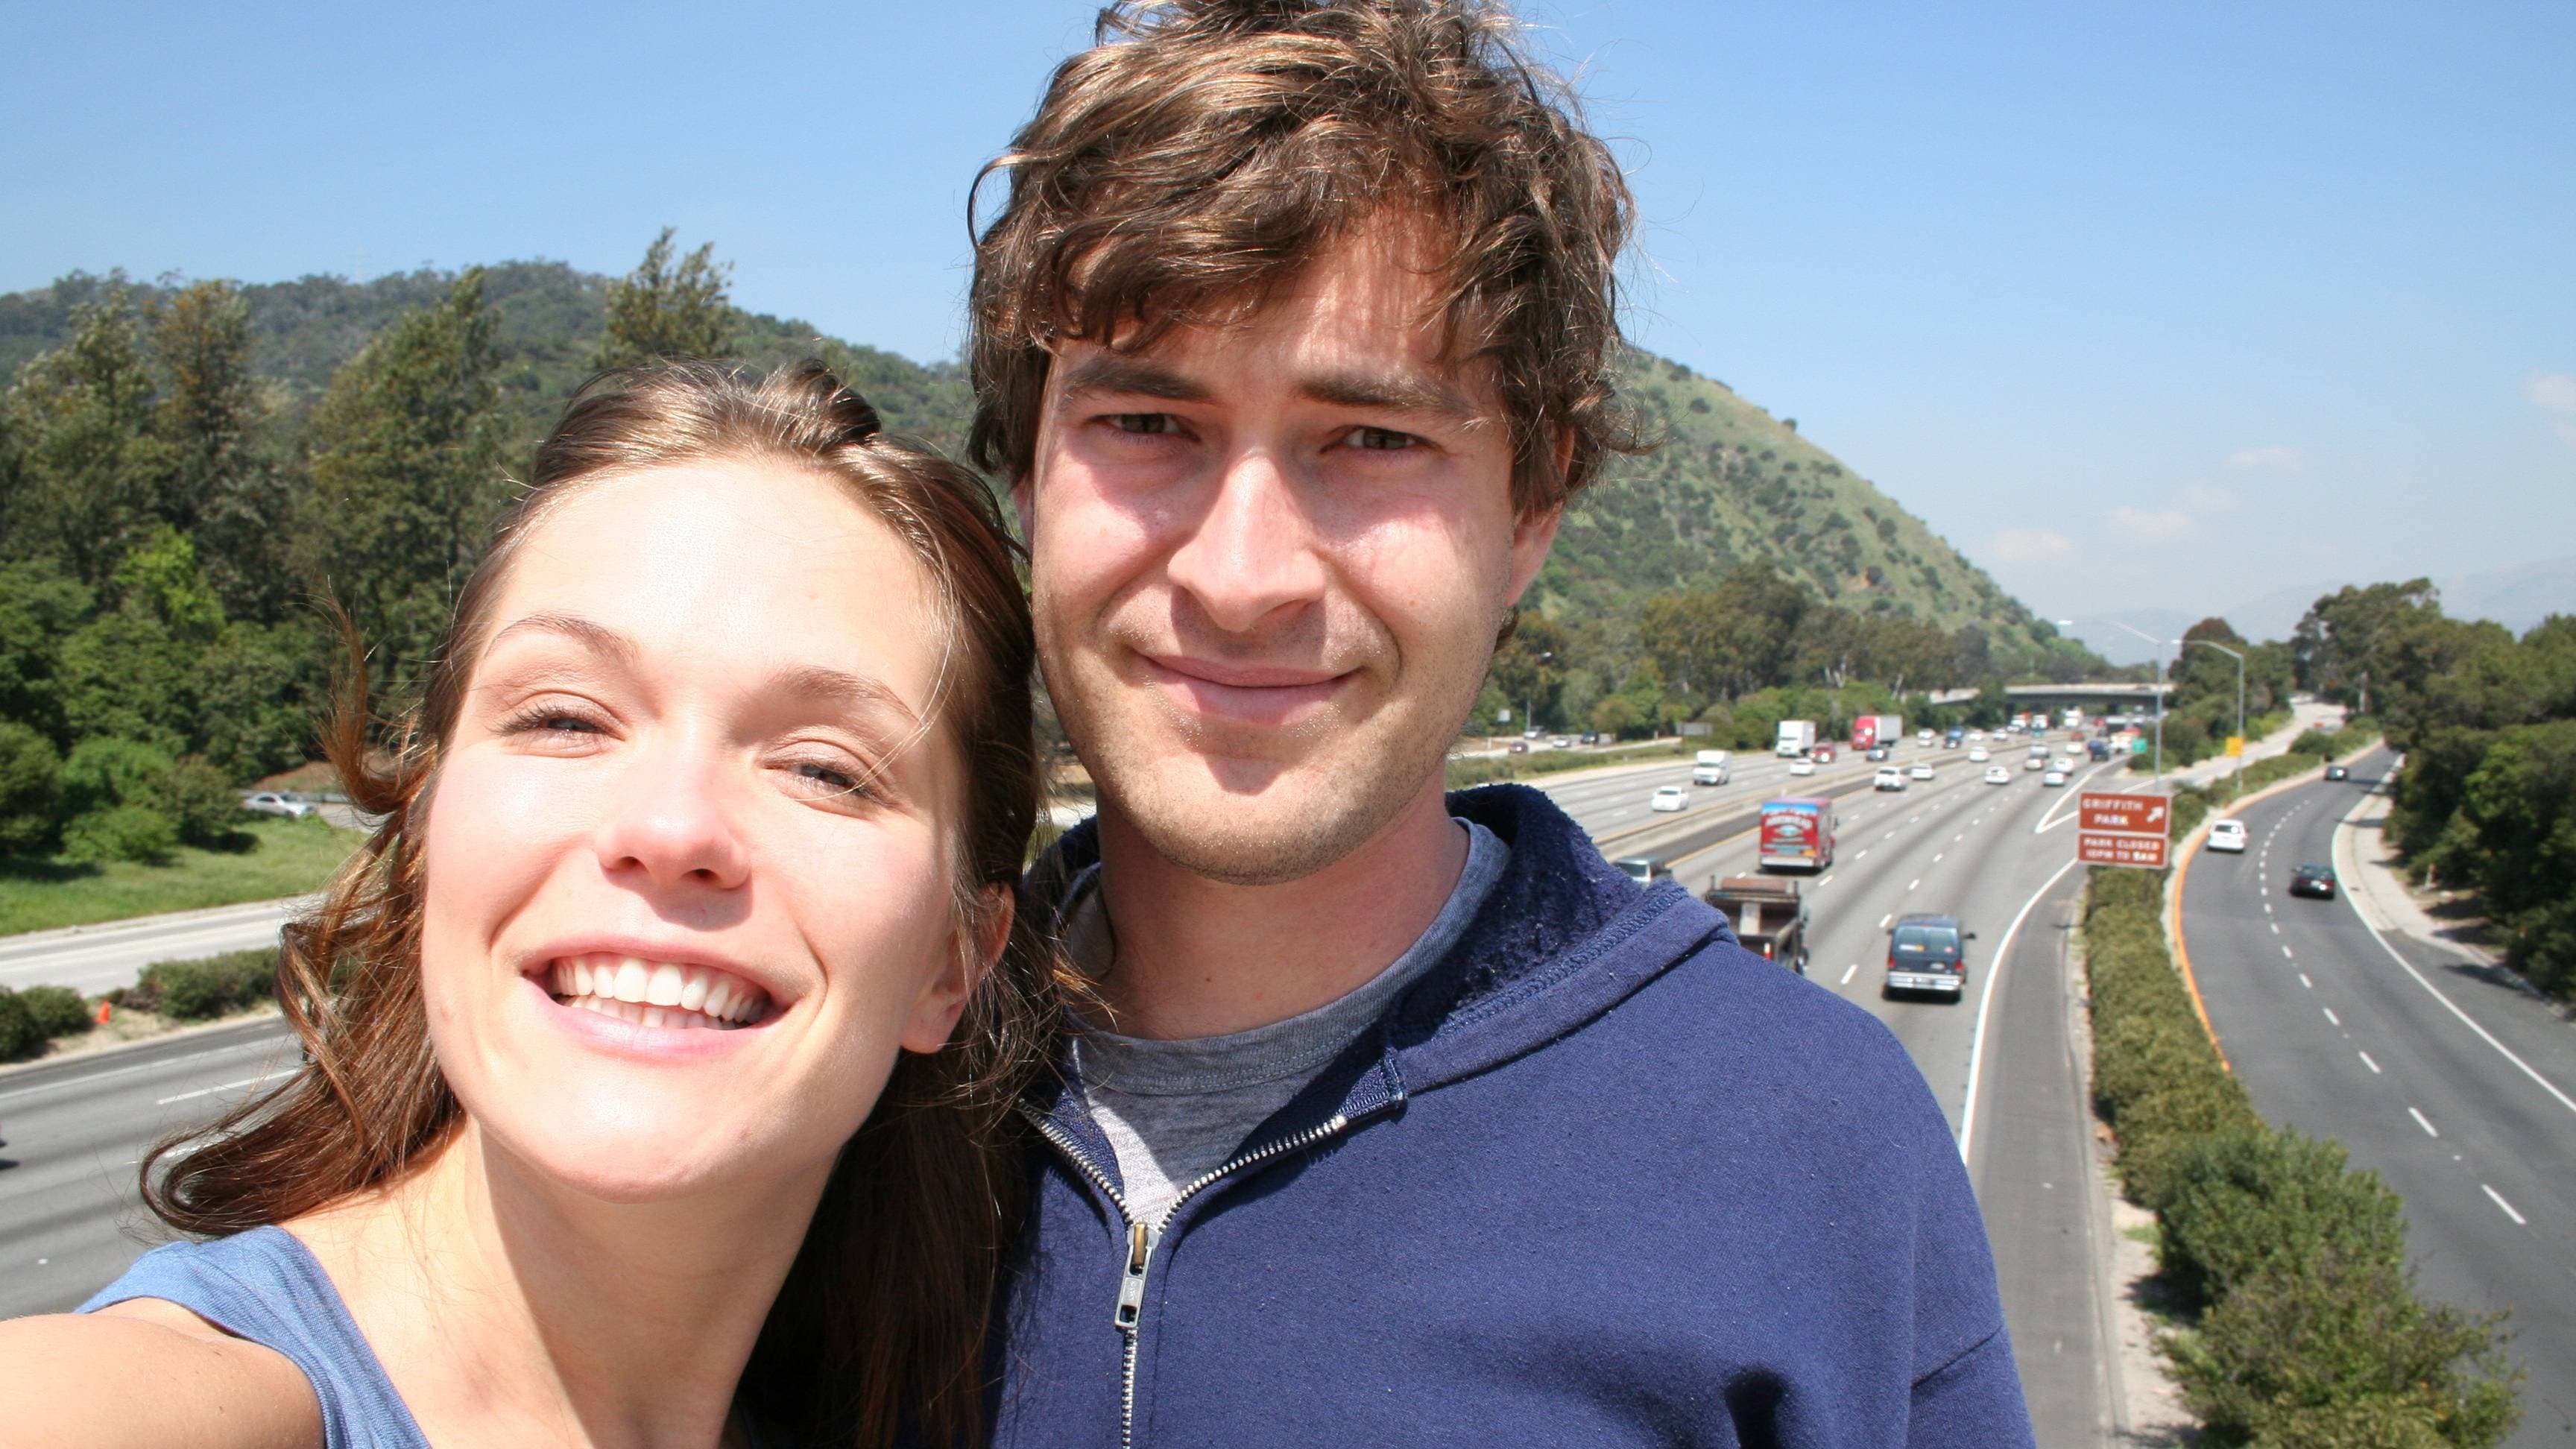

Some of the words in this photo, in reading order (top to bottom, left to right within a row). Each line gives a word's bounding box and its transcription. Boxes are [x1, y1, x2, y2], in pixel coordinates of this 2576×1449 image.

[2082, 798, 2144, 811] GRIFFITH
[2094, 814, 2129, 825] PARK
[2083, 838, 2112, 847] PARK
[2116, 840, 2159, 850] CLOSED
[2116, 850, 2130, 859] TO
